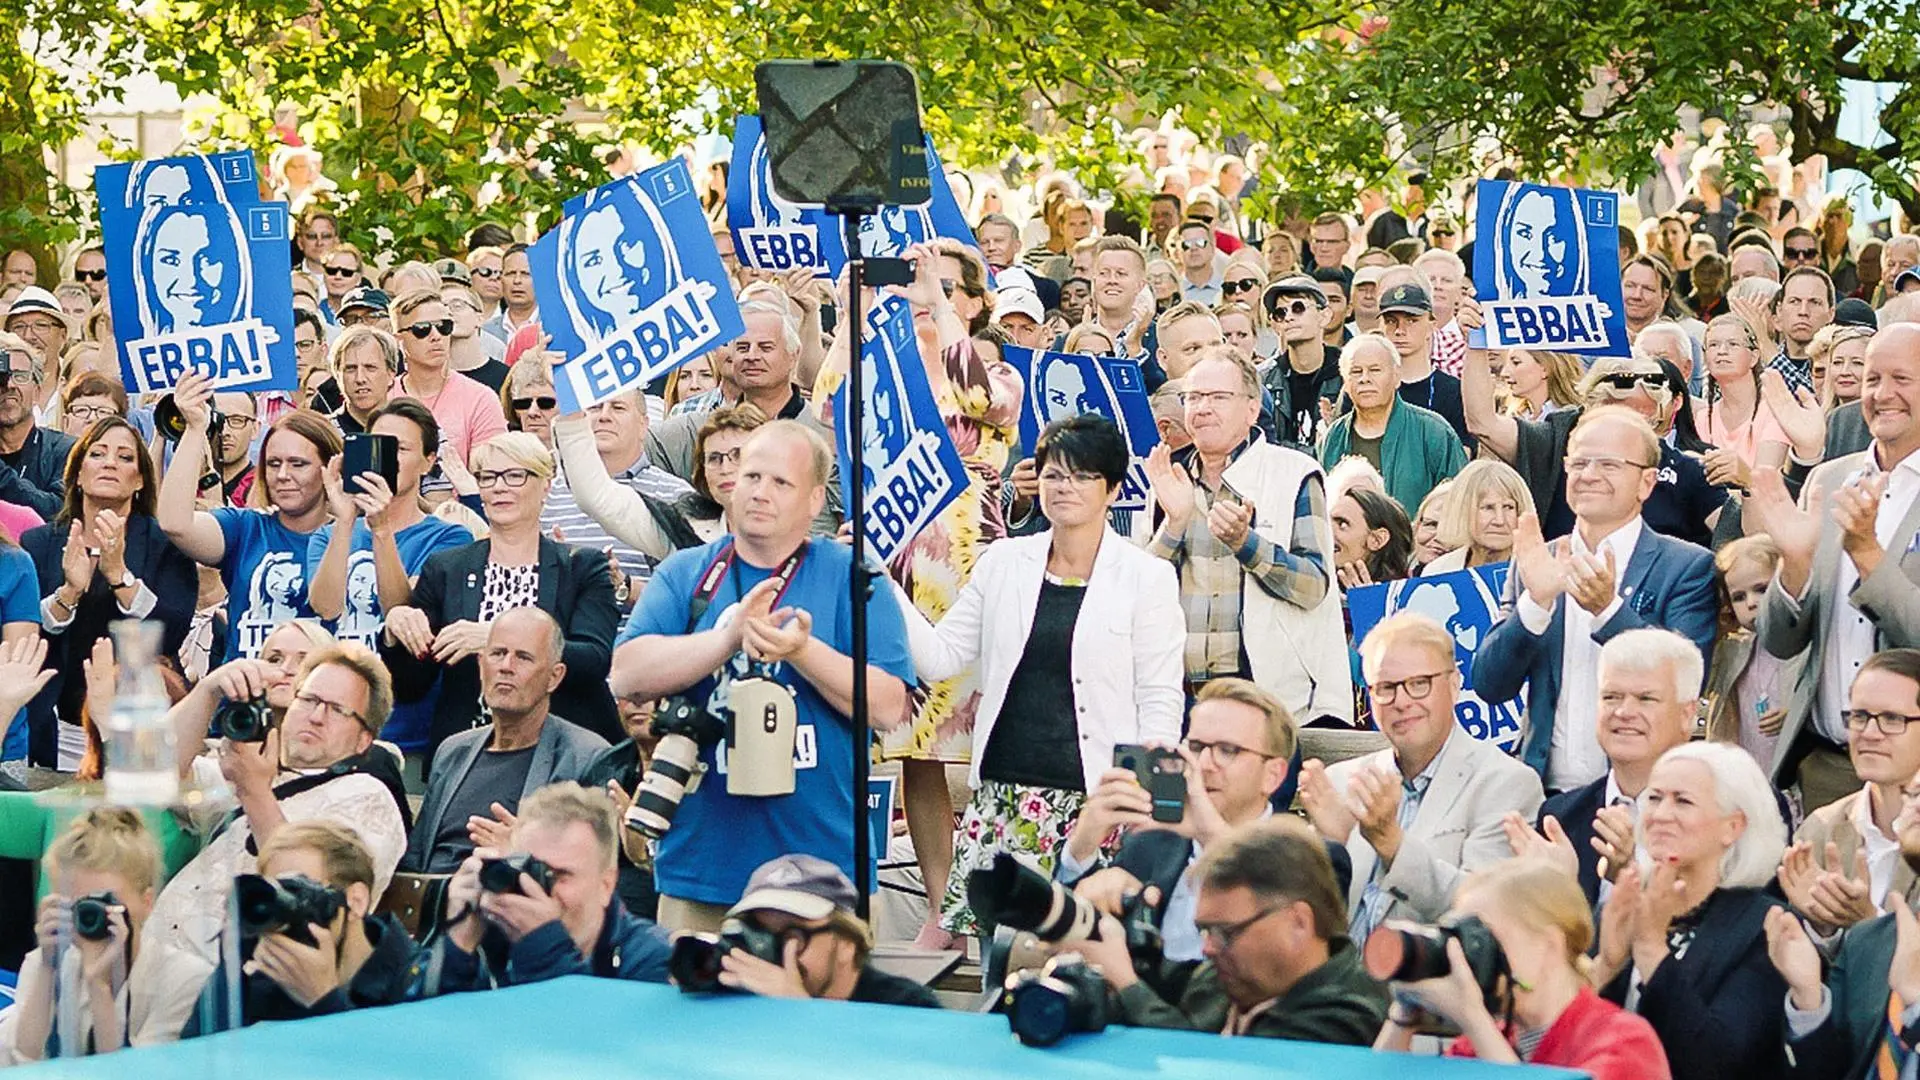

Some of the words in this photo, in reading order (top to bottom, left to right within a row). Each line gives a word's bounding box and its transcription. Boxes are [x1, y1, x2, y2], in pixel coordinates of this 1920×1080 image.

[139, 329, 262, 390] EBBA!
[582, 292, 709, 400] EBBA!
[1493, 303, 1602, 345] EBBA!
[862, 444, 943, 561] EBBA!
